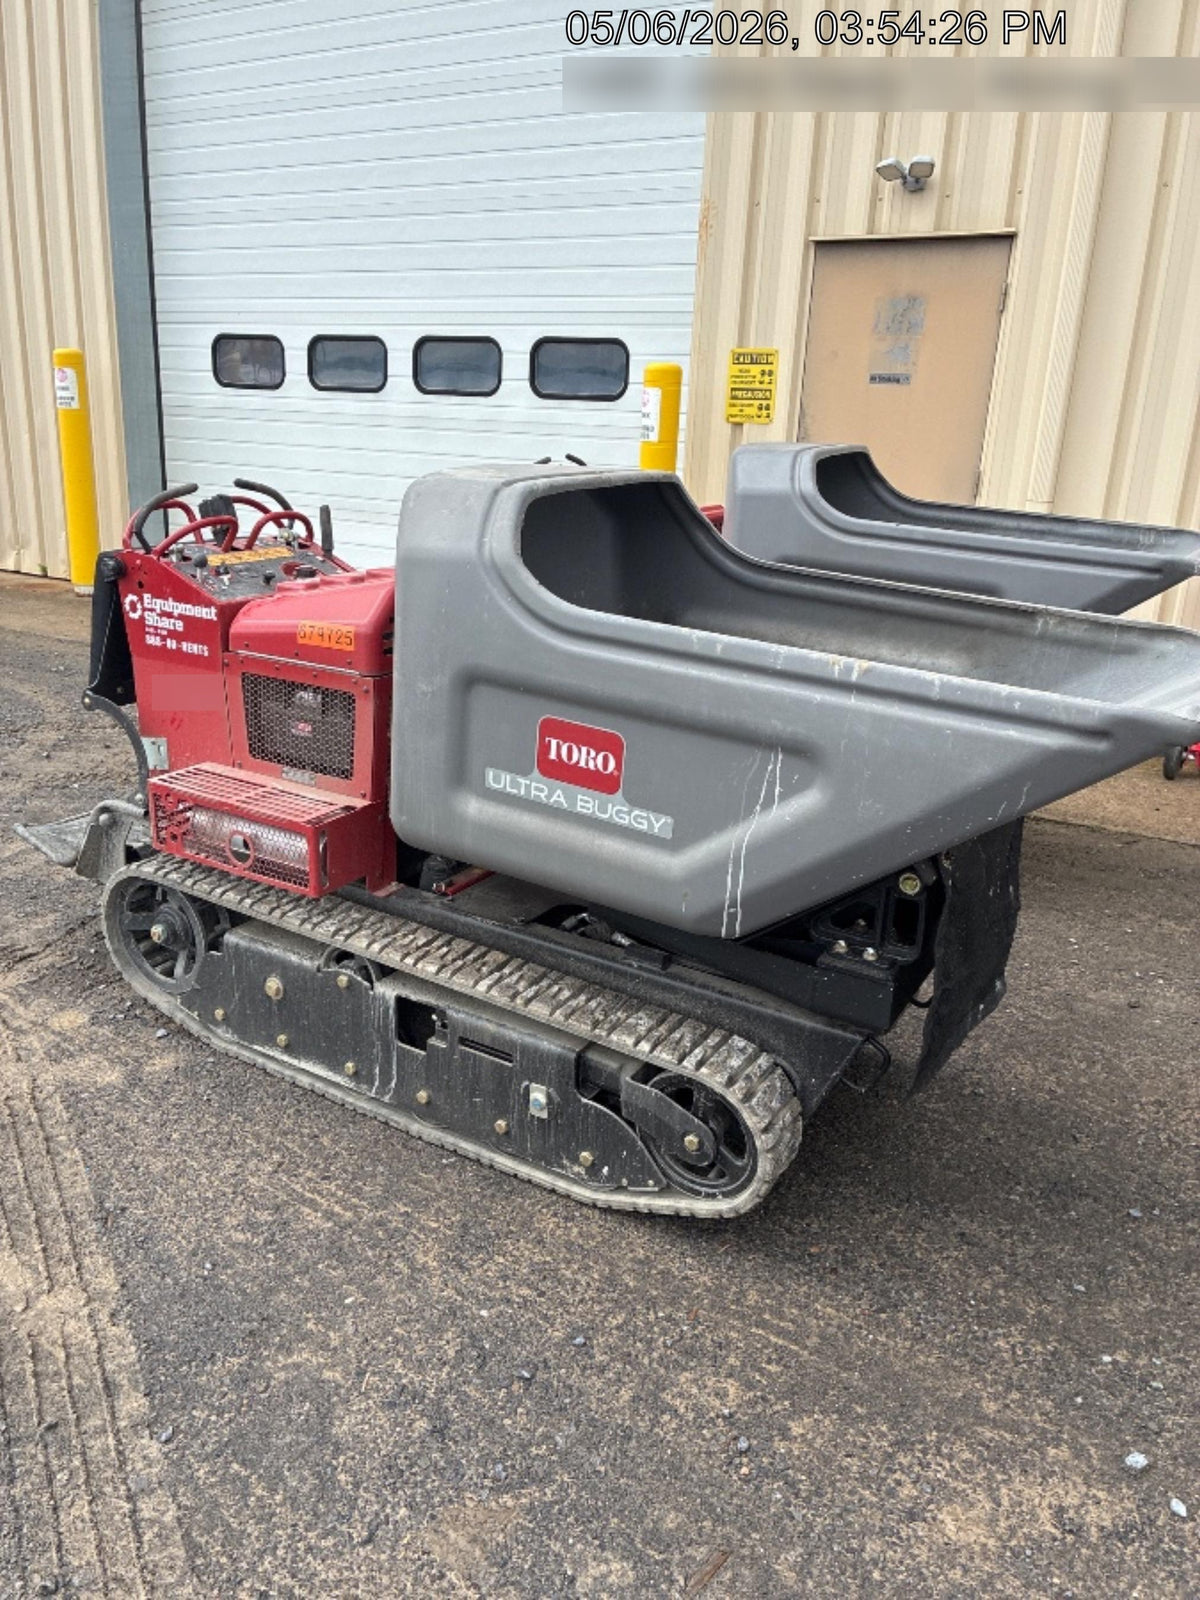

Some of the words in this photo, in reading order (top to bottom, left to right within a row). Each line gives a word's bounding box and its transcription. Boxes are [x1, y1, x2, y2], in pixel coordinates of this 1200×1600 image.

[143, 593, 218, 621] Equipment
[144, 611, 183, 632] Share
[545, 737, 617, 775] TORO
[488, 770, 568, 808] ULTRA
[576, 794, 668, 833] BUGGY
